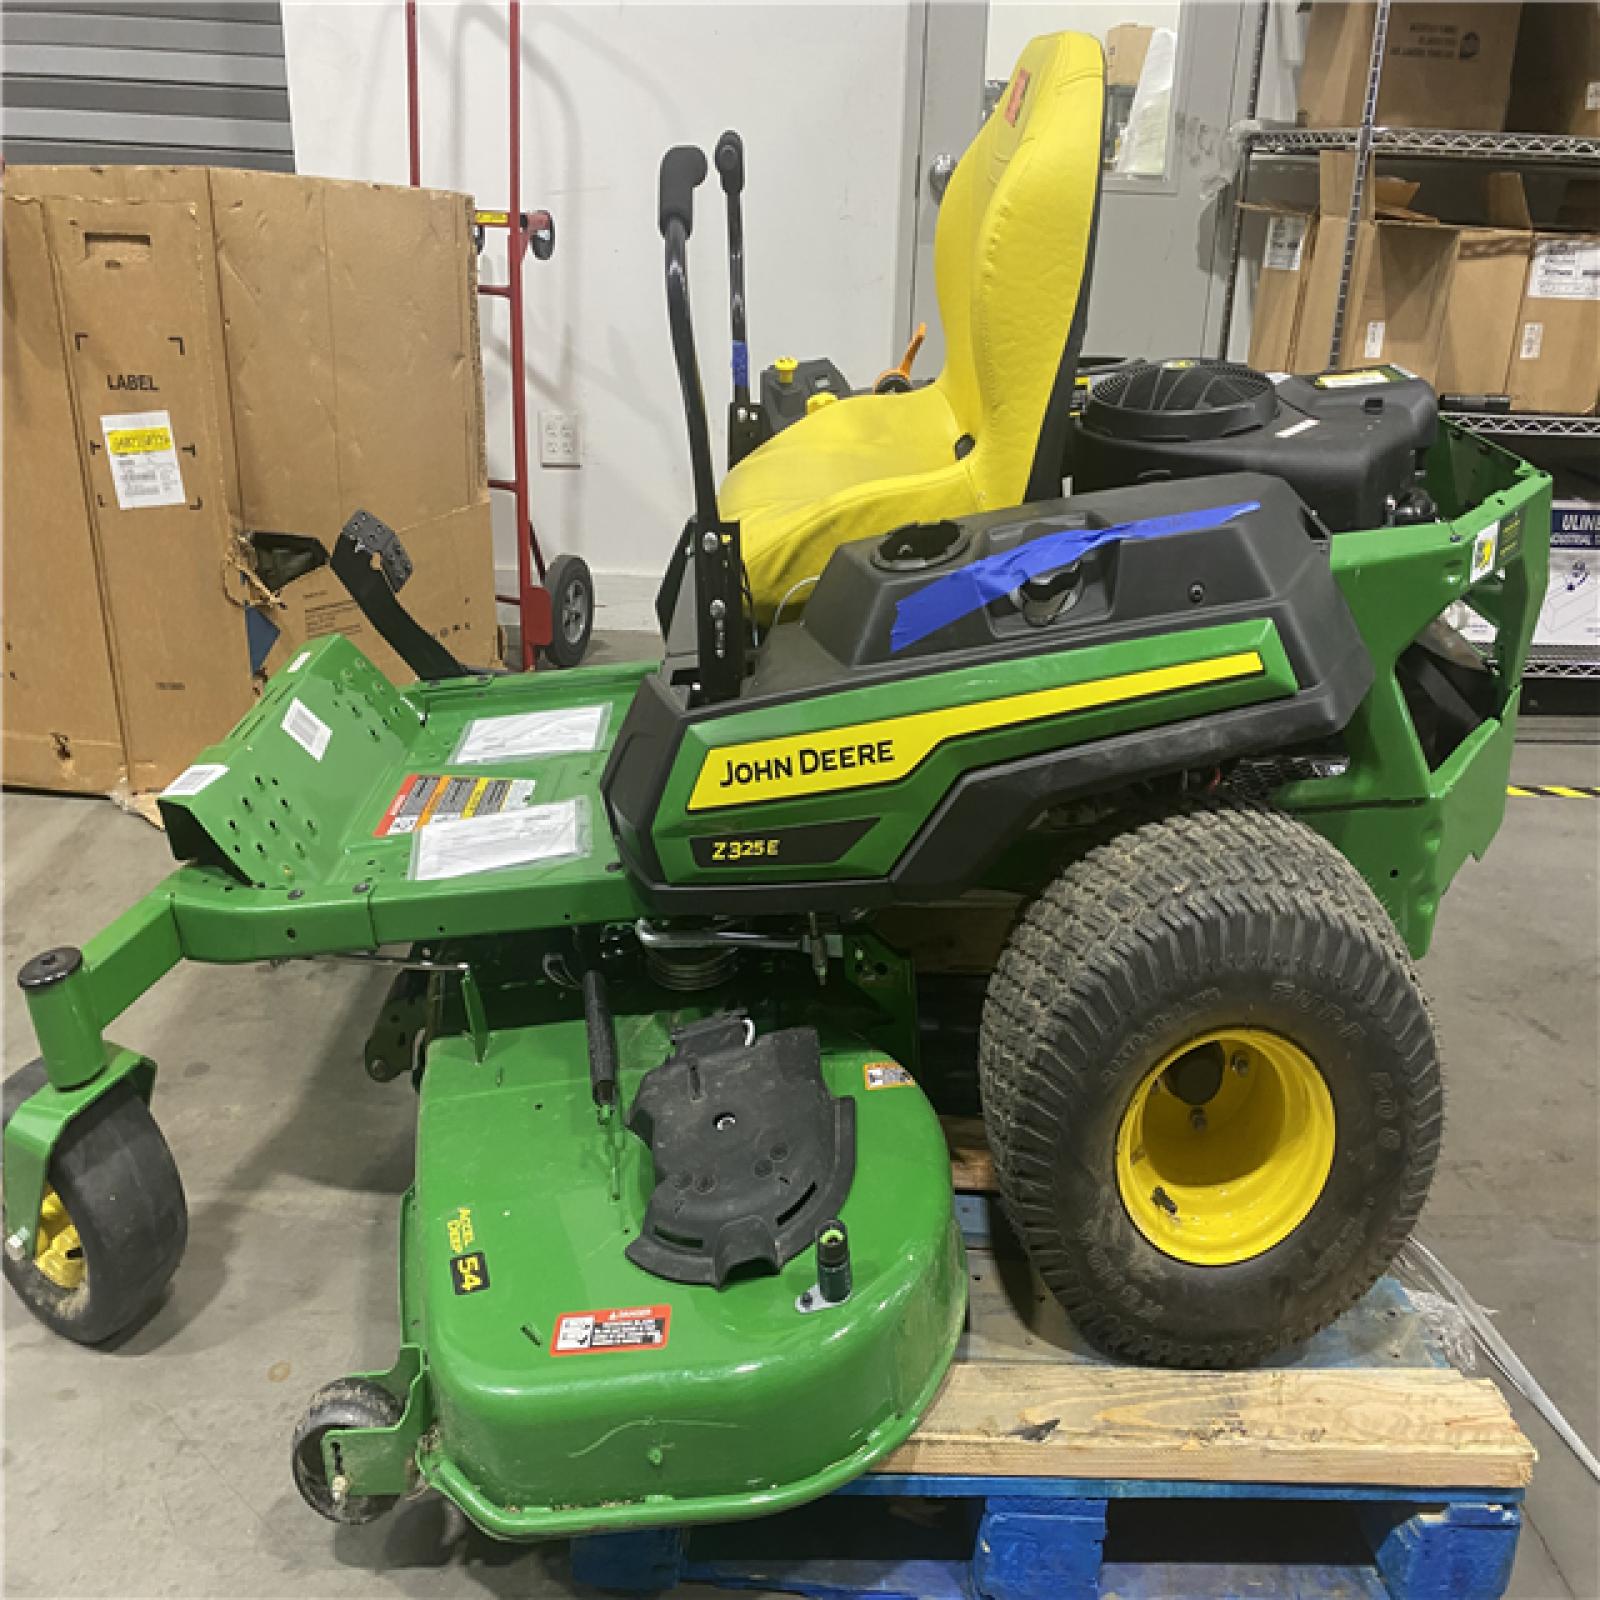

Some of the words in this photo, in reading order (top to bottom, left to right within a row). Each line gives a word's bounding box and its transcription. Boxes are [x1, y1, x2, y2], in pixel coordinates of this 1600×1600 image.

[106, 374, 160, 391] LABEL
[719, 756, 794, 788] JOHN
[799, 739, 896, 776] DEERE
[457, 1256, 483, 1292] 54
